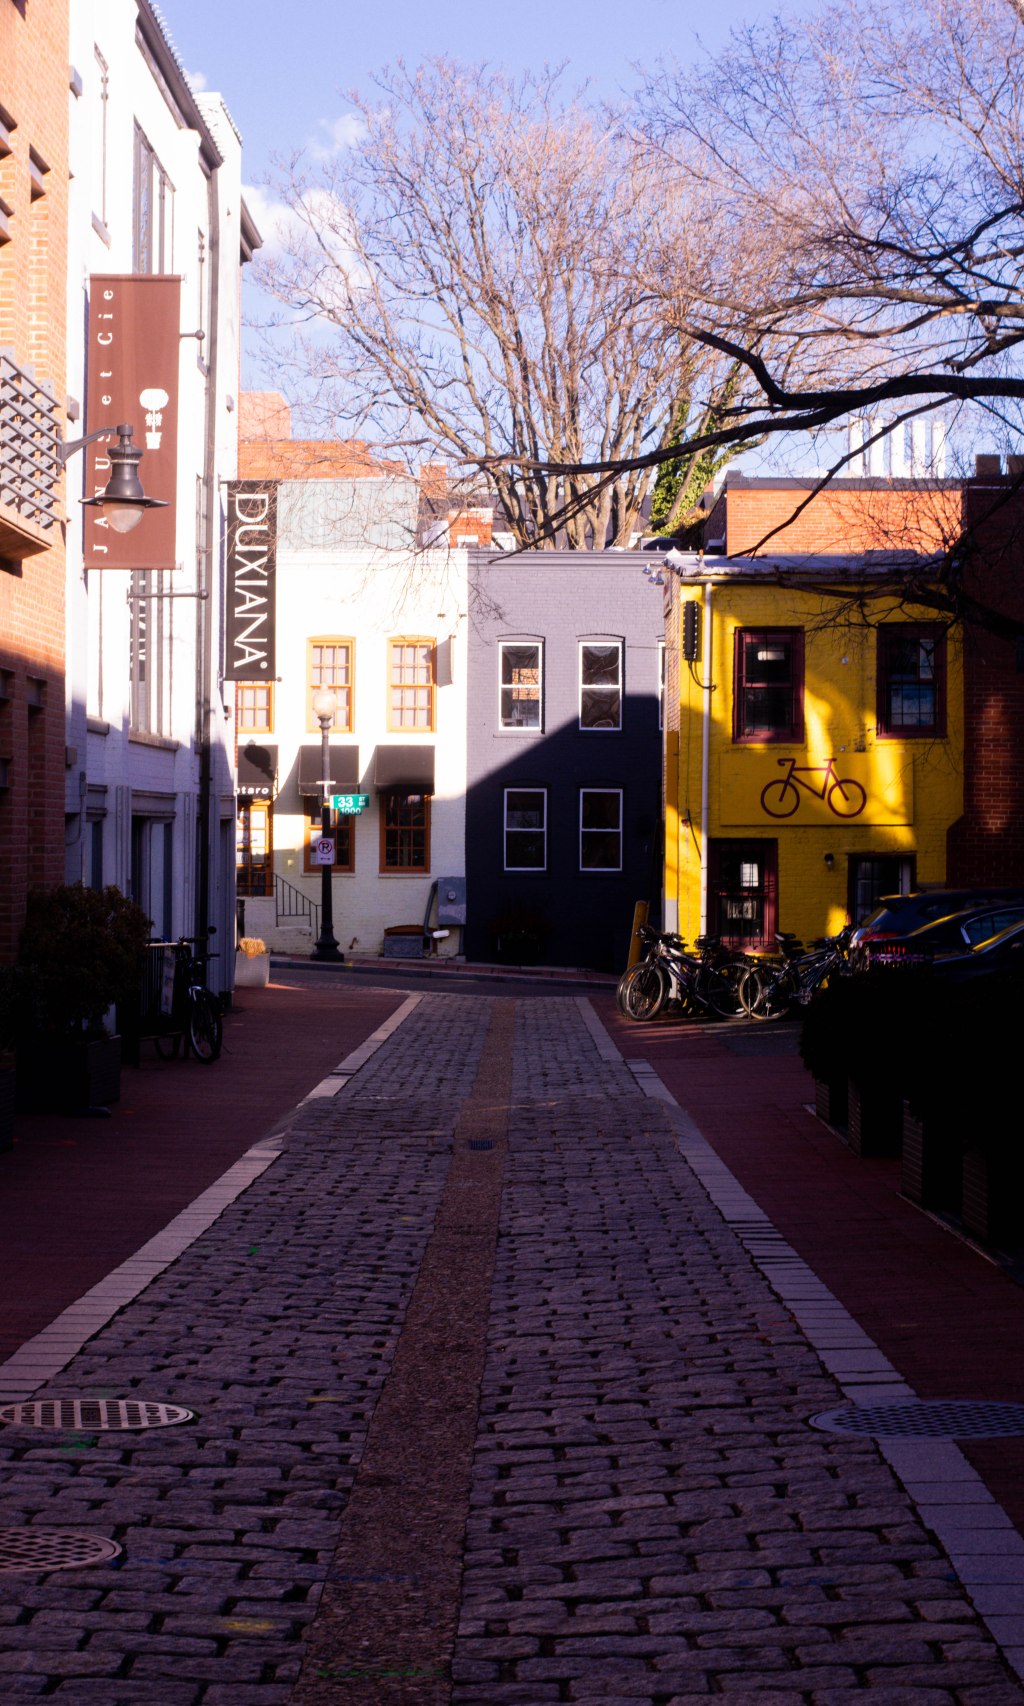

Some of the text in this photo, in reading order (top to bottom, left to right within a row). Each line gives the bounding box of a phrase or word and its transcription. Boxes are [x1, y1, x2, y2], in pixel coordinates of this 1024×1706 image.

[97, 290, 114, 346] Cie
[100, 370, 113, 406] et
[233, 493, 269, 669] DUXIANA
[338, 796, 354, 808] 33
[341, 807, 362, 815] 1000
